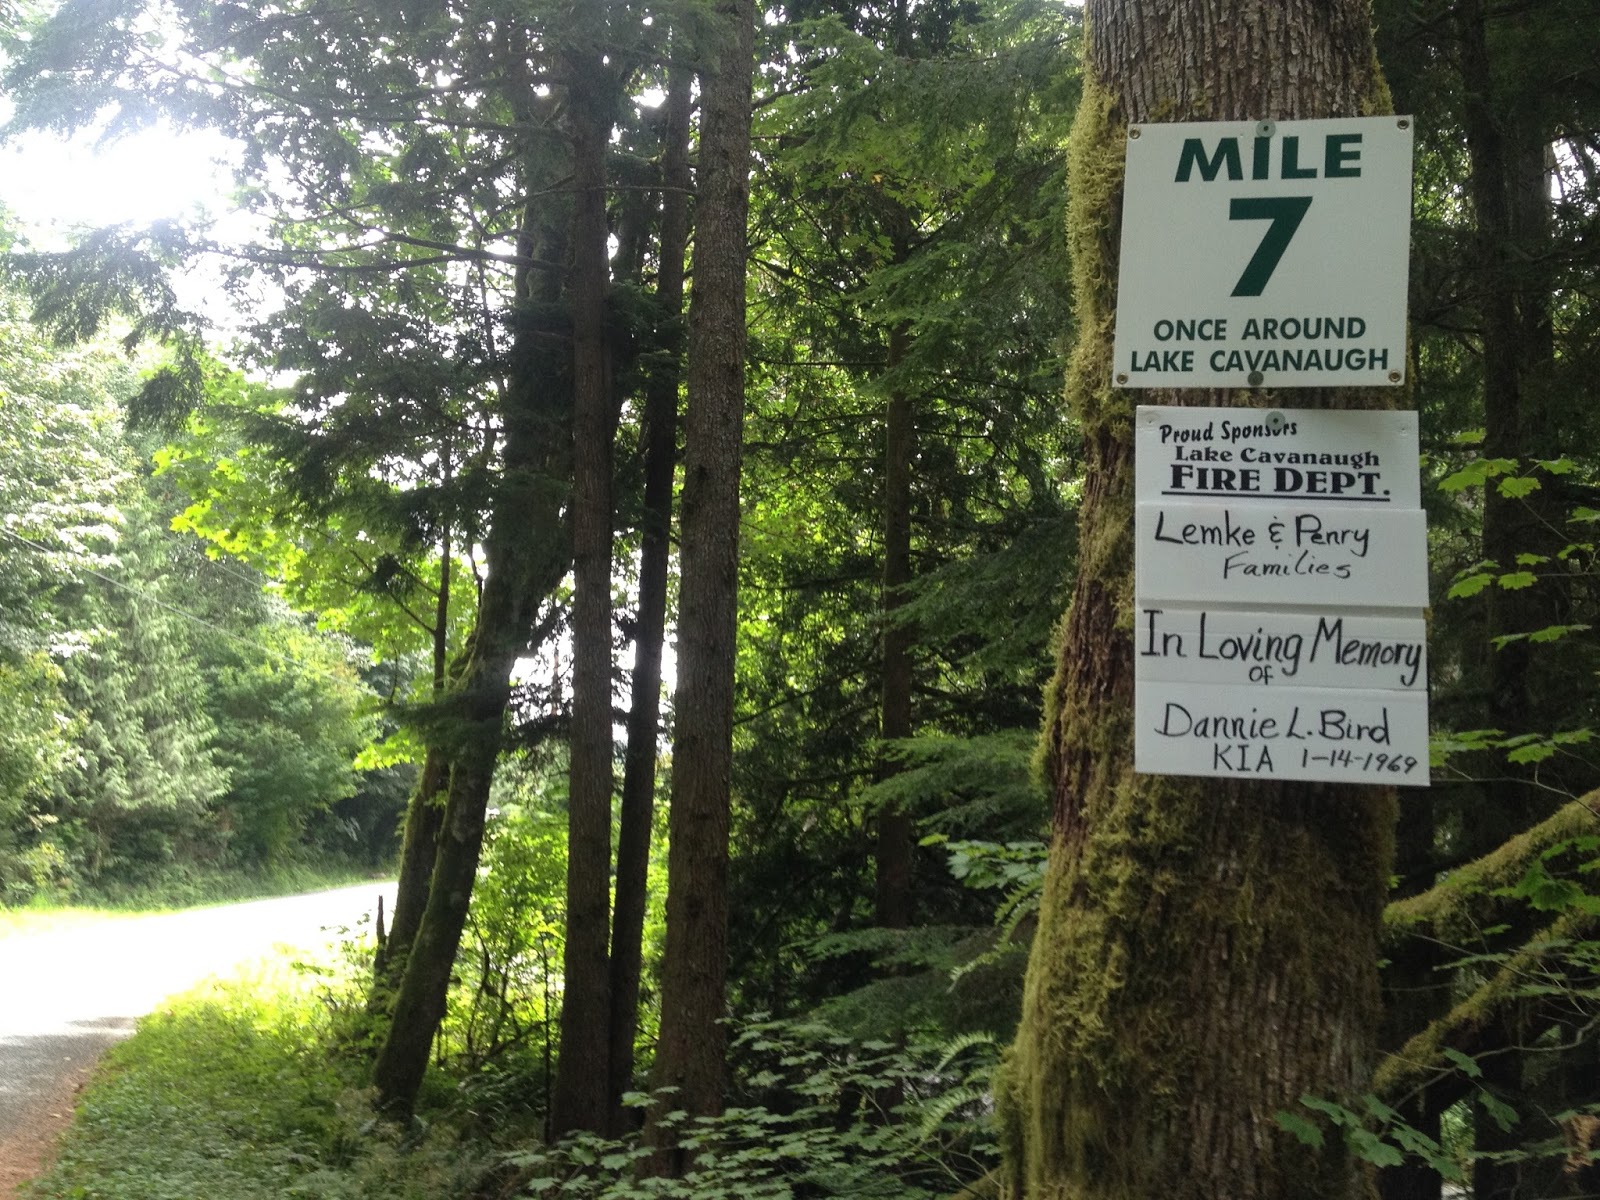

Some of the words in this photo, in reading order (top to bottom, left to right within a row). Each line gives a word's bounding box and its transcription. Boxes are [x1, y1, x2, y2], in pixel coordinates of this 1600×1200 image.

[1174, 134, 1362, 182] MILE
[1229, 196, 1313, 297] 7
[1153, 319, 1227, 341] ONCE
[1242, 317, 1366, 340] AROUND
[1131, 351, 1194, 372] LAKE
[1210, 348, 1388, 372] CAVANAUGH
[1160, 422, 1214, 444] Proud
[1175, 446, 1233, 462] Lake
[1240, 448, 1380, 469] Cavanaugh
[1170, 464, 1260, 492] FIRE
[1274, 467, 1390, 496] DEPT.
[1154, 510, 1256, 547] Lemke
[1268, 516, 1286, 549] &
[1223, 550, 1351, 579] Families
[1140, 610, 1187, 658] In
[1200, 612, 1303, 676] Loving
[1310, 617, 1422, 686] Memory
[1154, 703, 1280, 738] Dannie
[1286, 706, 1313, 740] L.
[1318, 707, 1390, 745] Bird
[1213, 744, 1274, 772] KIA
[1302, 748, 1418, 774] 1-14-1969
